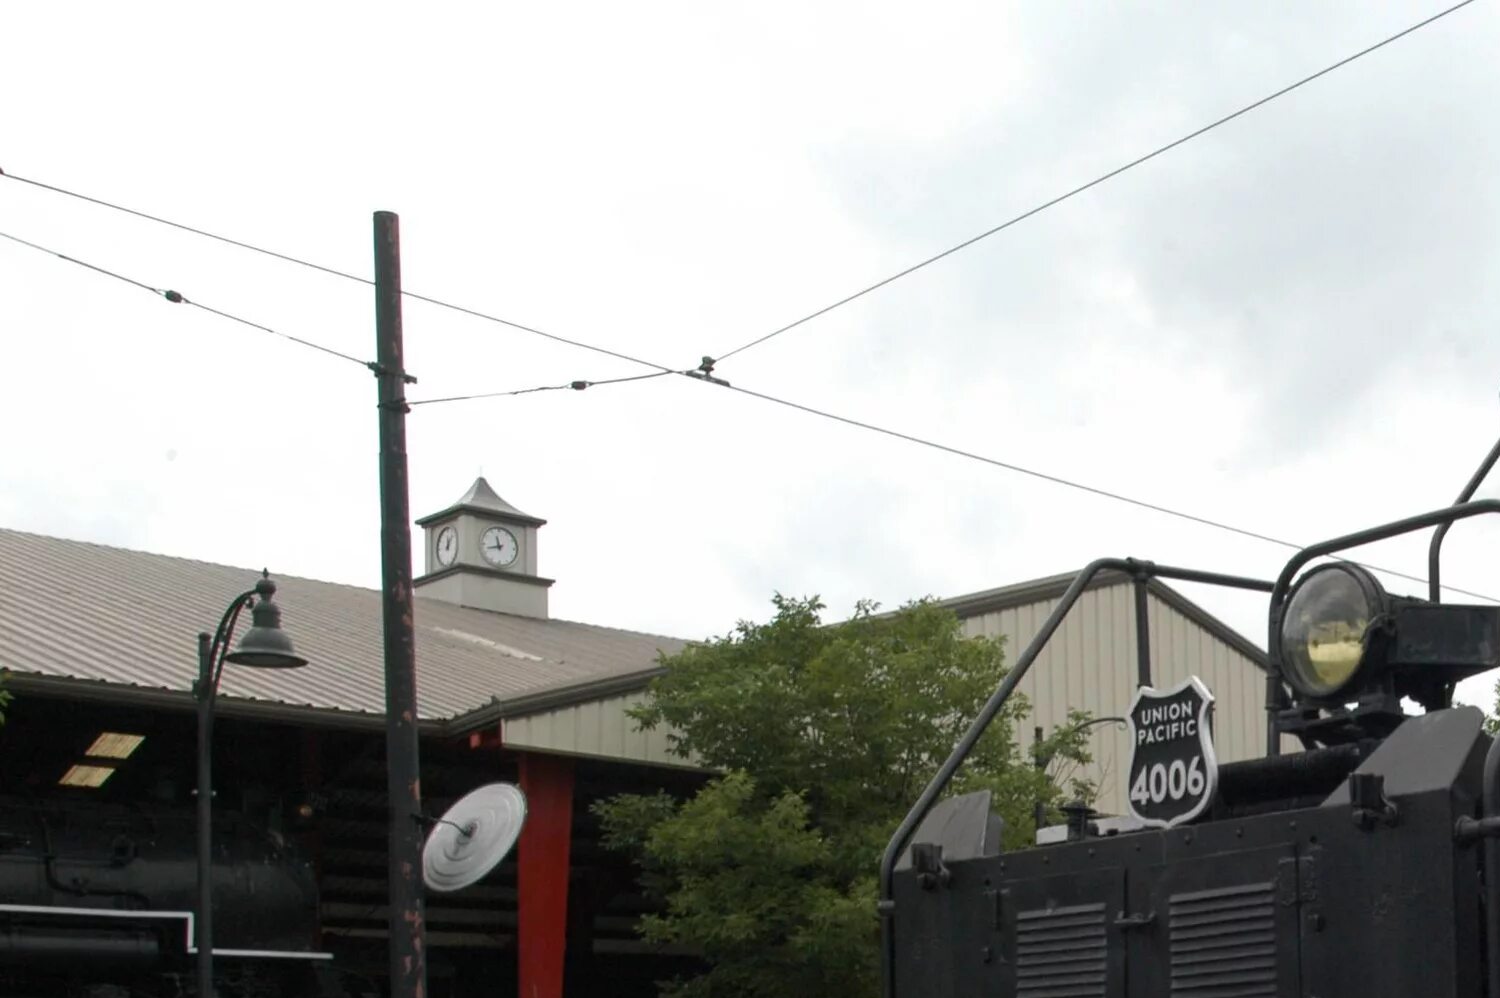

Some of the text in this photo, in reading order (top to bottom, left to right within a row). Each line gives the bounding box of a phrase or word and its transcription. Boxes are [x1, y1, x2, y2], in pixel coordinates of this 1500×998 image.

[1141, 700, 1193, 725] UNION
[1137, 718, 1197, 746] PACIFIC
[1130, 755, 1205, 806] 4006
